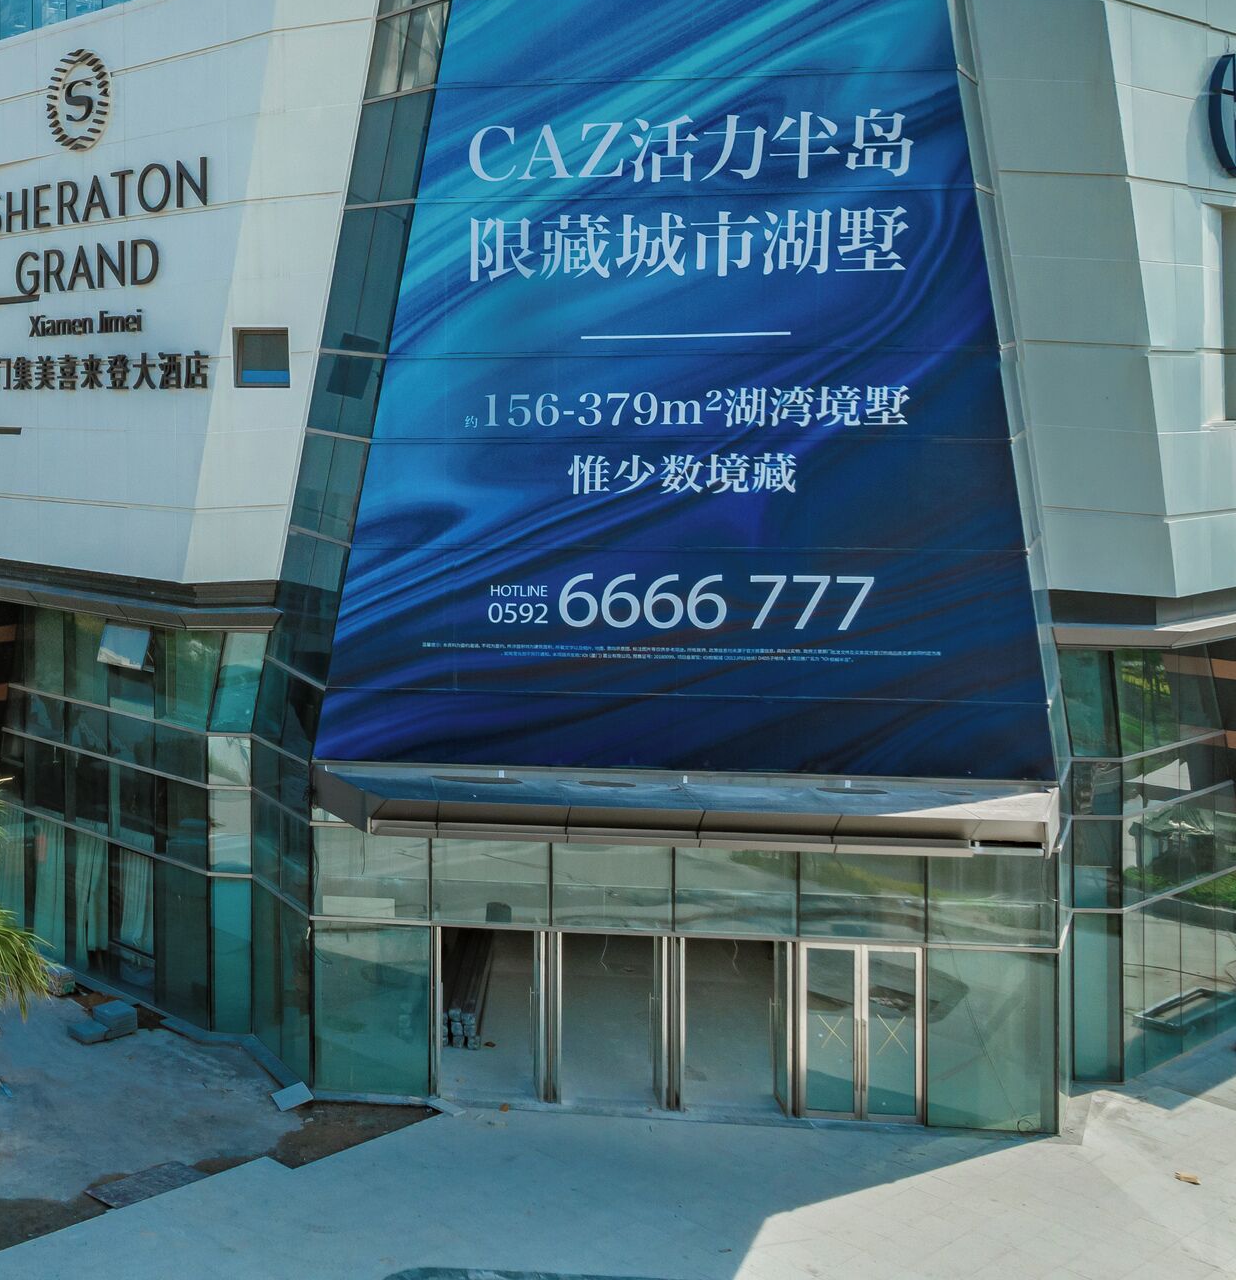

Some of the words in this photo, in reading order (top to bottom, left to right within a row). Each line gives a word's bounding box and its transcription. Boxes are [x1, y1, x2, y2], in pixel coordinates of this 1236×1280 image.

[468, 108, 915, 183] CAZ活力半岛
[14, 238, 160, 297] GRAND
[468, 205, 909, 283] 限藏城市湖墅
[28, 314, 94, 338] Xiamen
[97, 308, 144, 334] Jimei
[567, 452, 798, 495] 惟少数境藏
[487, 602, 549, 625] 0592
[558, 572, 728, 630] 6666
[749, 574, 876, 632] 777
[489, 584, 549, 598] HOTLINE
